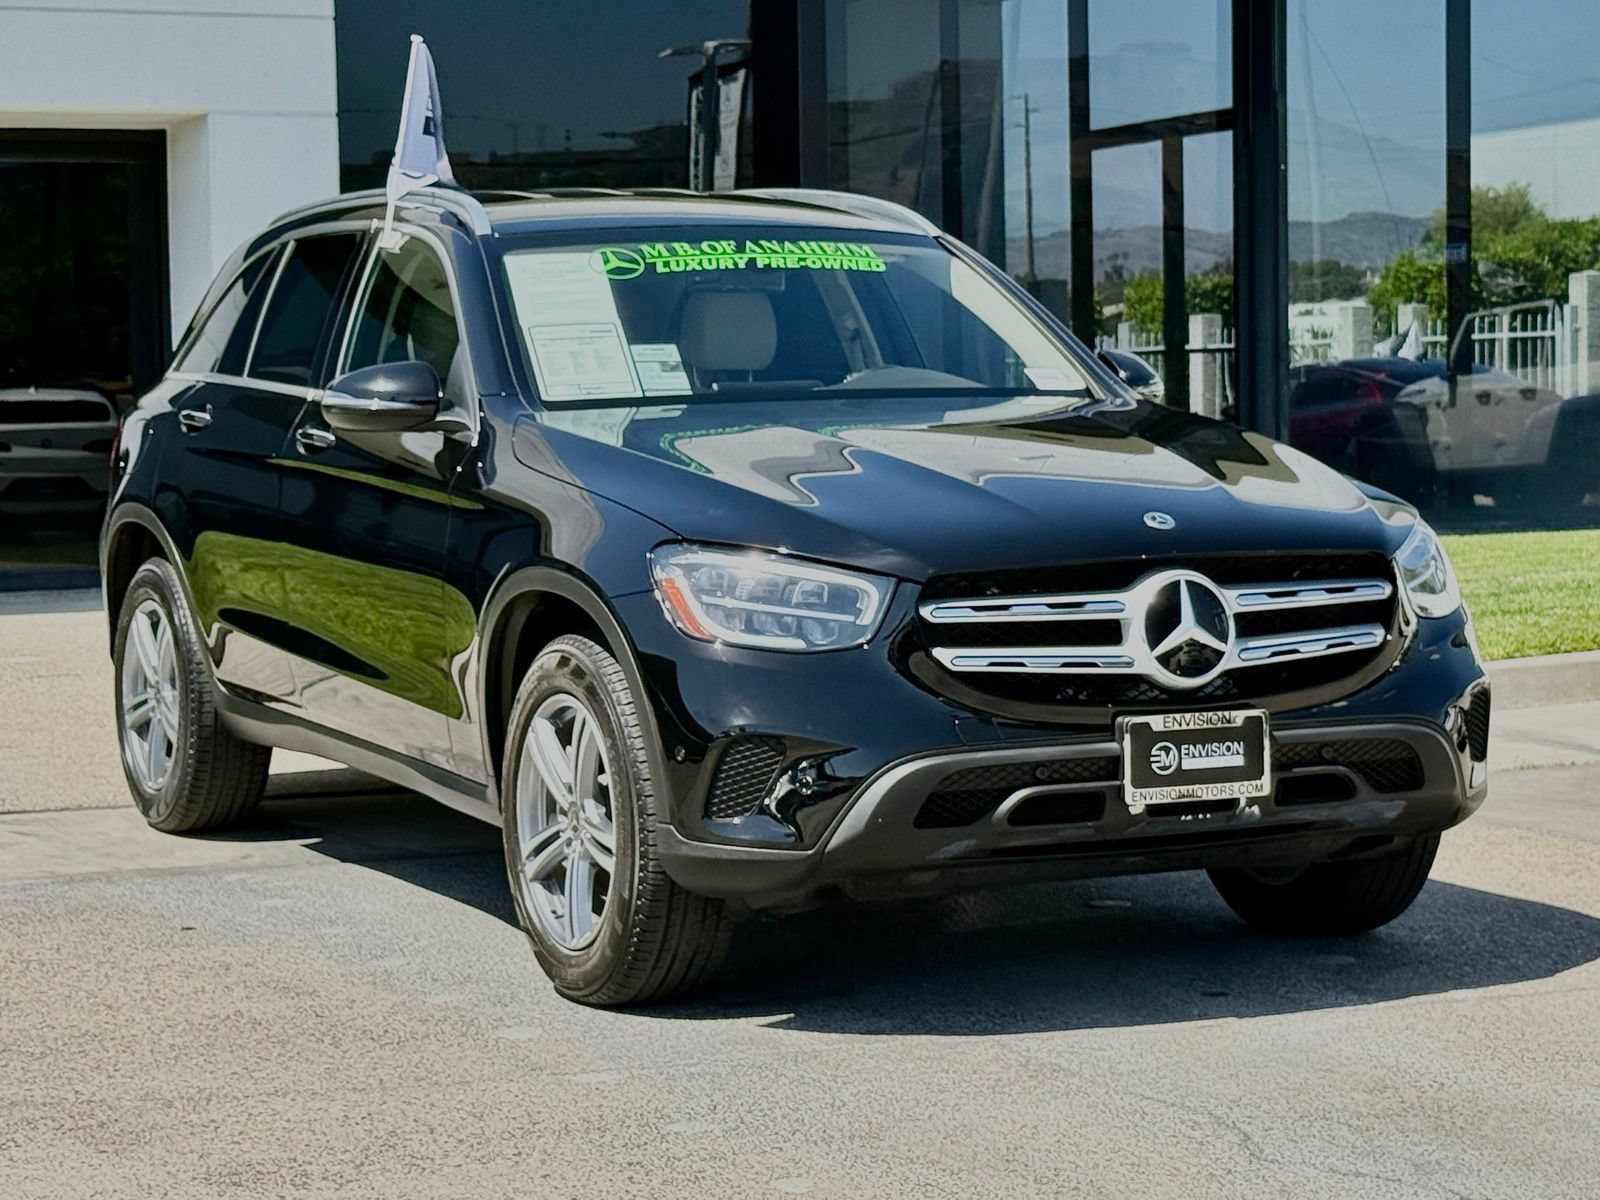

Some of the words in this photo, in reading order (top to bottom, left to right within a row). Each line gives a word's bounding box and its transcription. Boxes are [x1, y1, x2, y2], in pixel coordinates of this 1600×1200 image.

[745, 240, 878, 258] ANAHEIM
[655, 257, 749, 273] LUXURY
[756, 256, 887, 272] PRE-OWNED
[1162, 711, 1232, 729] ENVISION
[1181, 741, 1244, 758] ENVISION
[1131, 783, 1264, 802] ENVISIONMOTORS.COM
